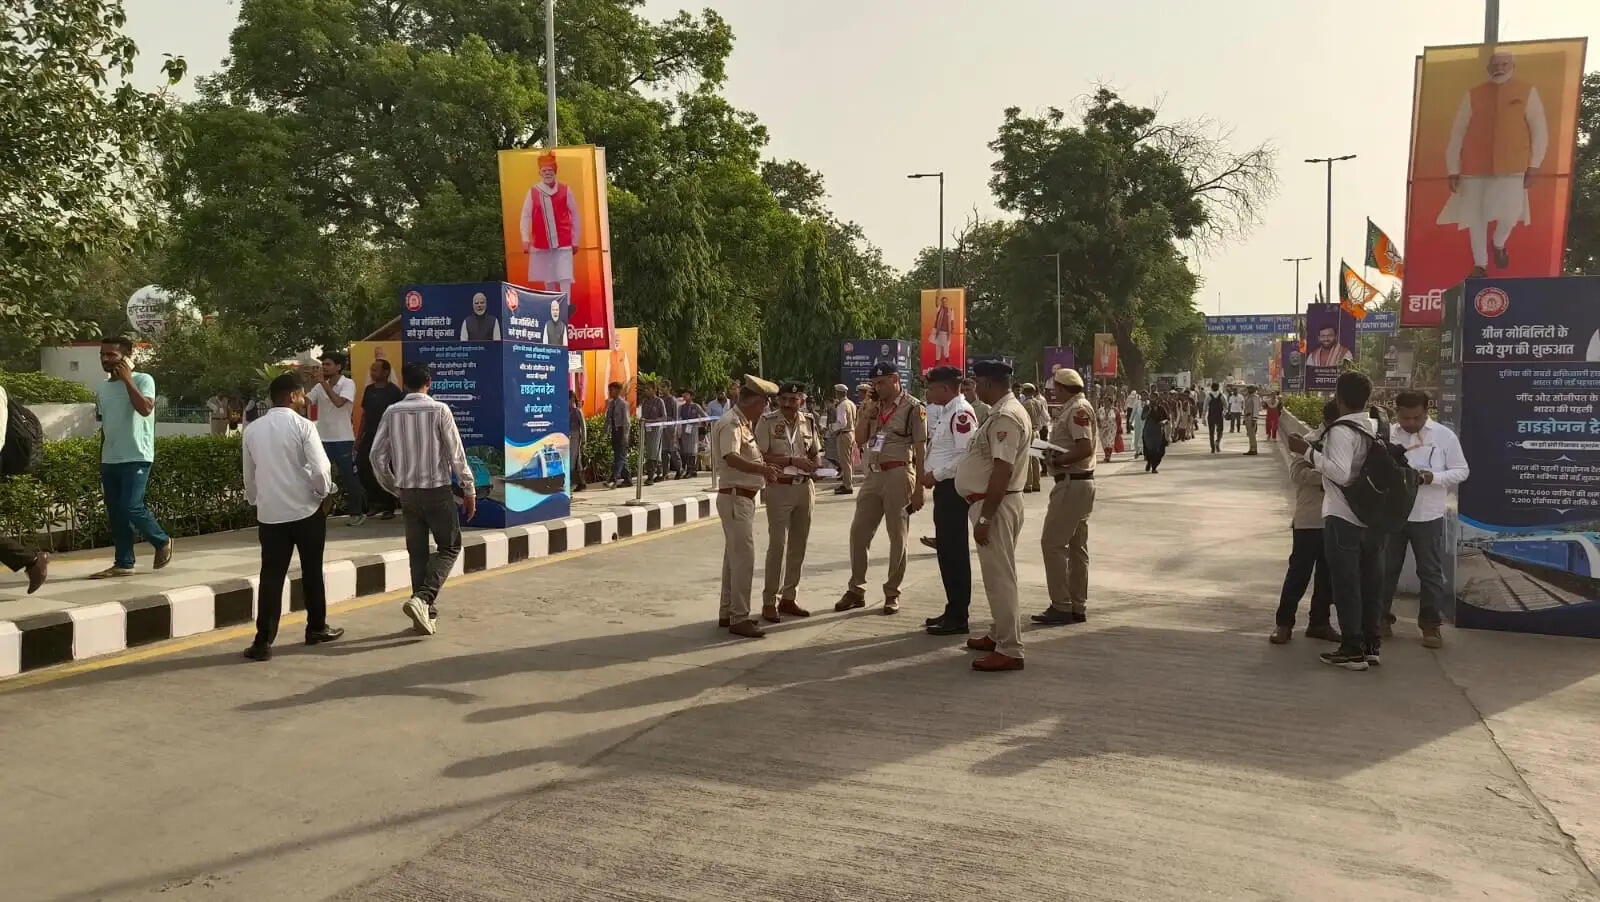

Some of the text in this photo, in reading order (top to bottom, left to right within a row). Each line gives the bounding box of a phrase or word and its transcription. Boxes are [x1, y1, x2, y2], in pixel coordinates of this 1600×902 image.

[568, 323, 604, 339] भिनंदन
[1481, 325, 1569, 339] ग्रीन मोबिलिटी के
[1475, 341, 1494, 355] नये
[1496, 343, 1512, 358] युग
[1514, 341, 1529, 355] की
[1535, 392, 1551, 401] और
[1589, 392, 1598, 402] के
[1533, 404, 1593, 414] भारत की पहली
[1516, 417, 1587, 434] हाइड्रोजन
